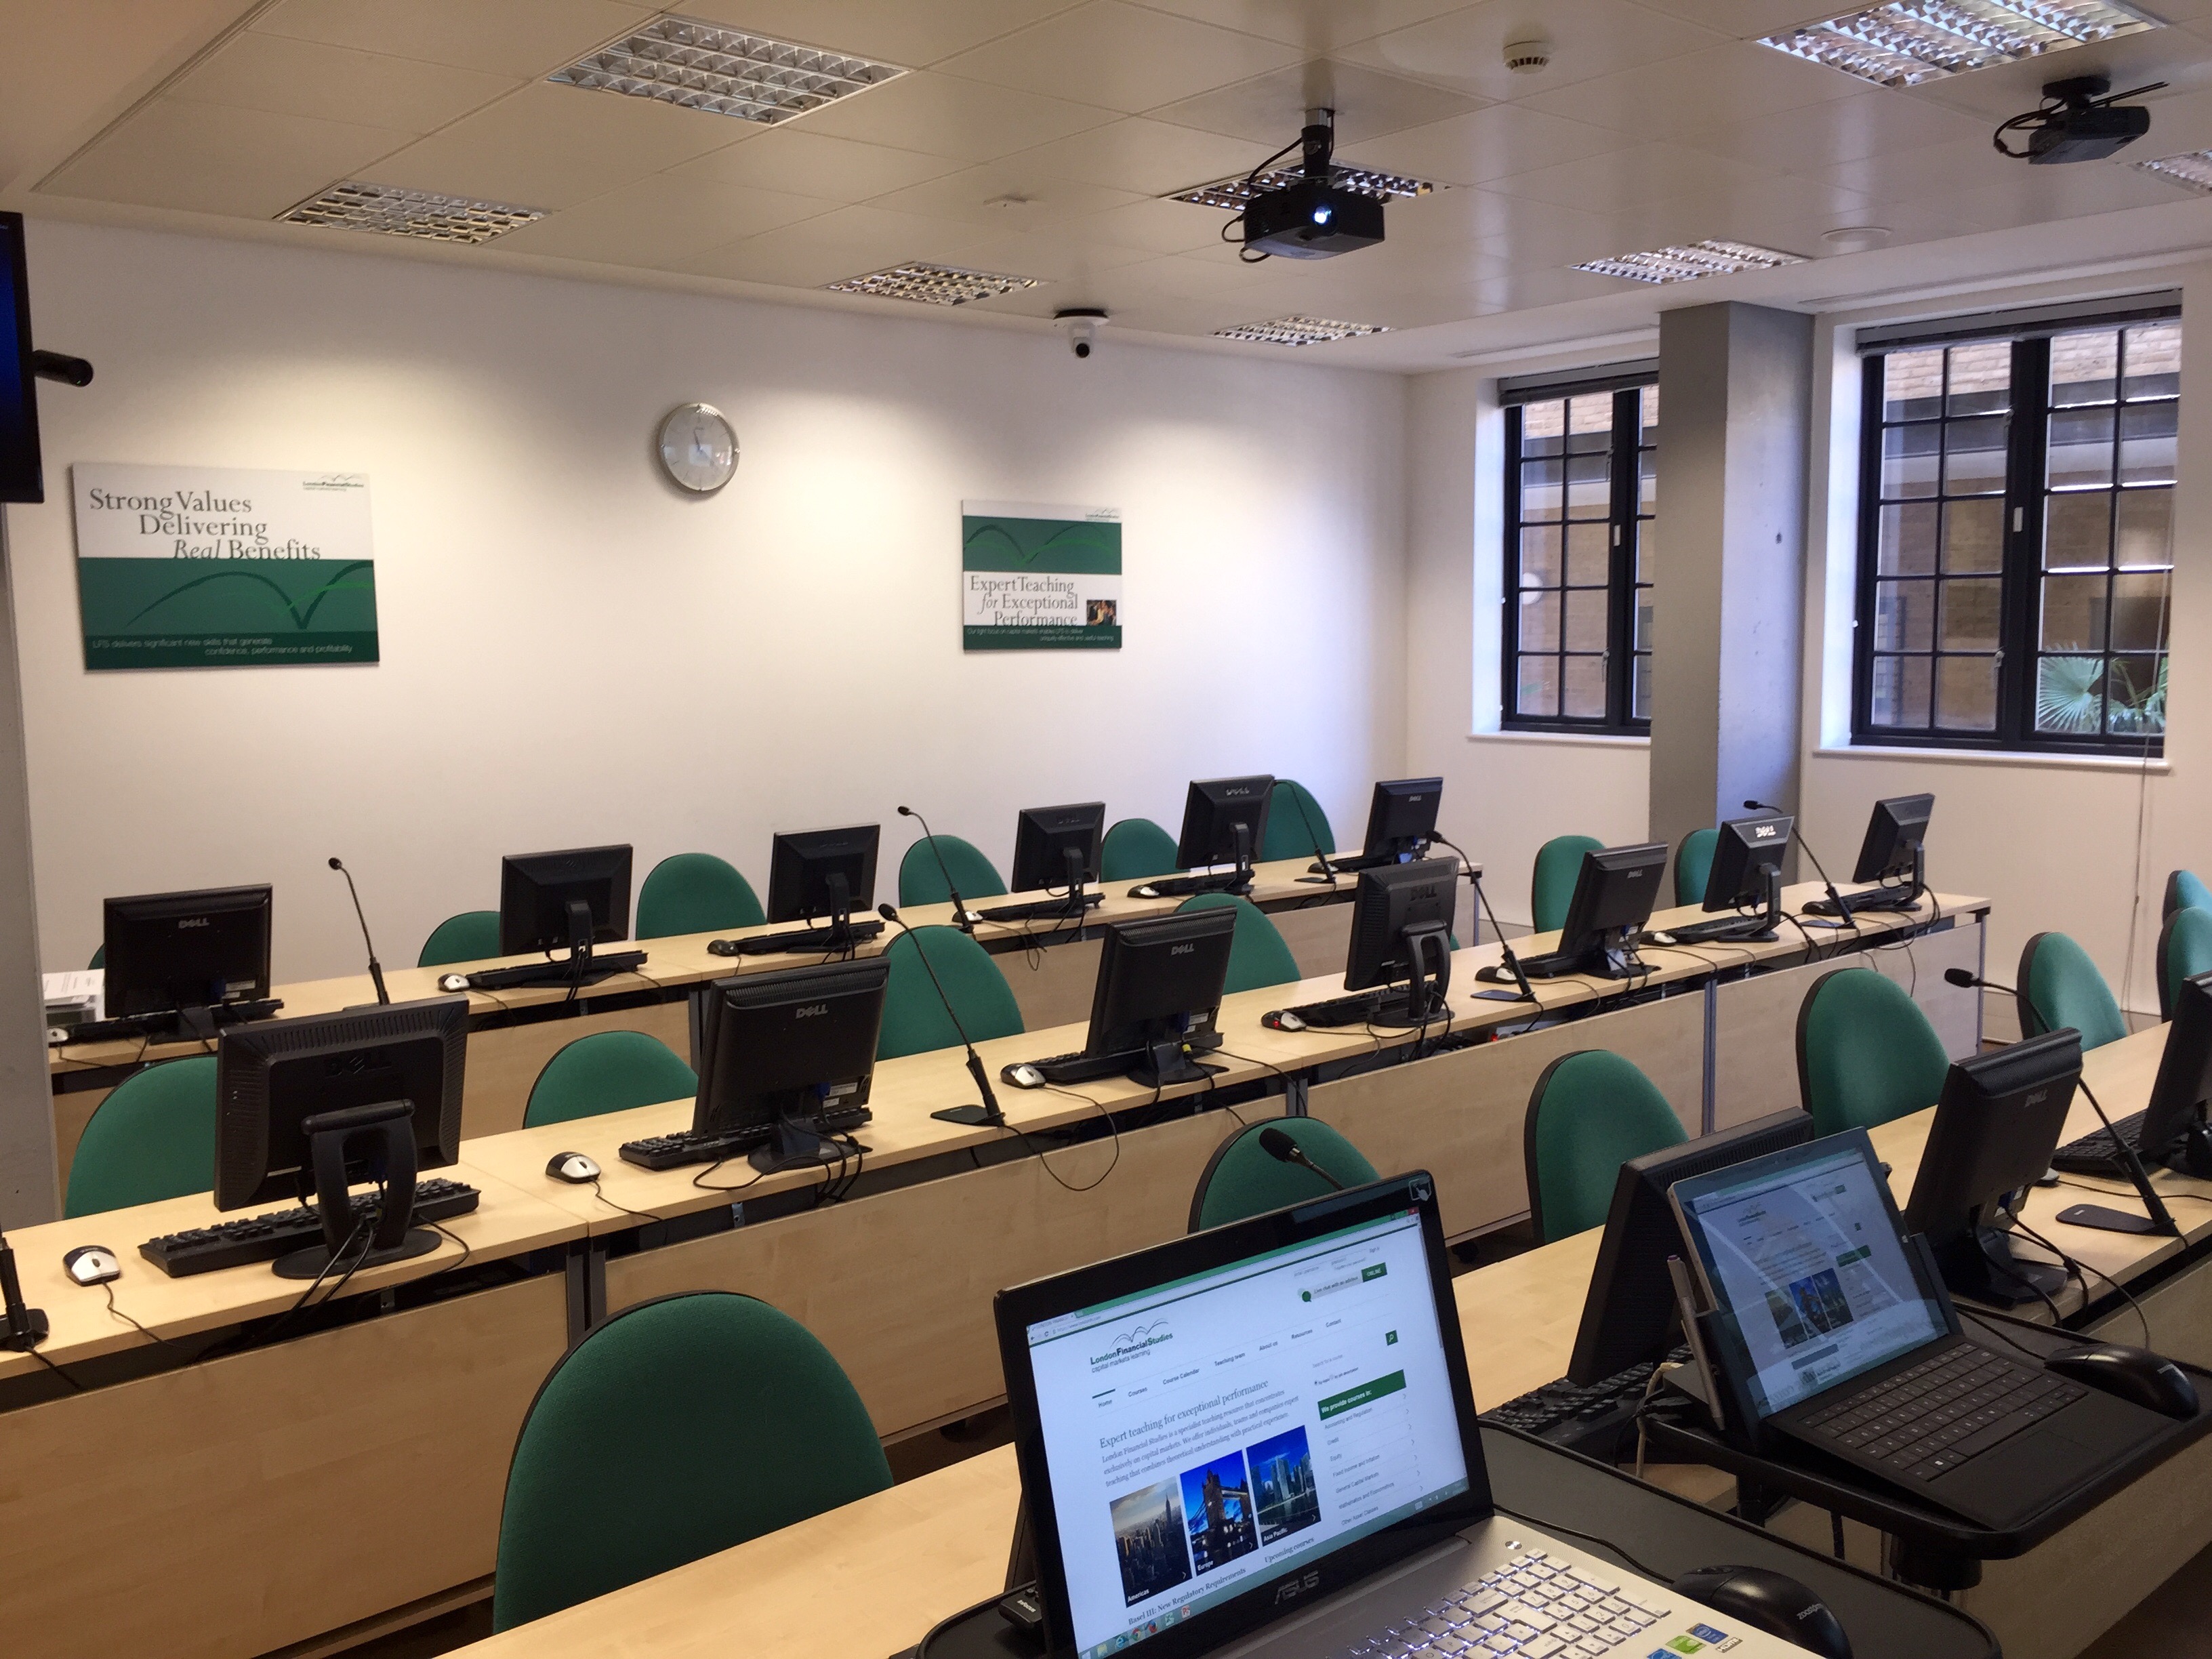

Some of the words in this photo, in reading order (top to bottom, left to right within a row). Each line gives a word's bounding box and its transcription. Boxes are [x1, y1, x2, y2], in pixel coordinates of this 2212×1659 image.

[89, 488, 173, 520] Strong
[175, 490, 252, 512] Values
[140, 513, 269, 546] Delivering
[173, 539, 222, 559] Real
[228, 538, 321, 560] Benefits
[970, 575, 1017, 597] Expert
[1017, 575, 1075, 599] Teaching
[977, 592, 999, 615] for
[1002, 593, 1079, 615] Exceptional
[994, 610, 1078, 626] Performance
[1755, 825, 1776, 838] DELL
[1627, 869, 1643, 878] DELL
[178, 917, 210, 929] DELL
[1170, 943, 1194, 956] DELL
[795, 1004, 829, 1019] DELL
[1325, 1318, 1342, 1328] Contact
[1291, 1329, 1313, 1339] Resources
[1089, 1332, 1174, 1366] LondonFinancialStudies
[1259, 1343, 1273, 1351] About
[1091, 1361, 1109, 1373] capital
[1109, 1355, 1130, 1368] markets
[1130, 1349, 1151, 1361] learning
[1214, 1355, 1235, 1366] Teaching
[1235, 1352, 1246, 1360] team
[1162, 1375, 1179, 1385] Course
[1179, 1368, 1200, 1379] Calendar
[1128, 1387, 1148, 1397] Courses
[1098, 1399, 1113, 1408] Home
[1321, 1405, 1330, 1414] We
[1330, 1399, 1347, 1412] provide
[1347, 1391, 1366, 1404] courses
[1099, 1431, 1128, 1449] Expert
[1128, 1418, 1164, 1437] teaching
[1164, 1413, 1176, 1425] for
[1177, 1395, 1221, 1419] exceptional
[1222, 1380, 1269, 1406] performance
[1353, 1407, 1373, 1419] Regulation
[1102, 1450, 1124, 1463] London
[1123, 1439, 1149, 1455] Financial
[1149, 1433, 1168, 1446] Studies
[1177, 1420, 1202, 1436] specialist
[1202, 1410, 1224, 1424] teaching
[1223, 1405, 1245, 1418] resource
[1244, 1399, 1254, 1409] that
[1254, 1390, 1285, 1405] concentrates
[1103, 1458, 1132, 1475] exclusively
[1141, 1448, 1159, 1462] capital
[1159, 1441, 1182, 1454] markets.
[1182, 1435, 1191, 1445] We
[1191, 1431, 1204, 1441] offer
[1233, 1415, 1248, 1425] teams
[1248, 1410, 1258, 1420] and
[1258, 1401, 1284, 1415] companies
[1284, 1395, 1299, 1406] expert
[1327, 1437, 1339, 1446] Credit
[1105, 1473, 1129, 1488] teaching
[1129, 1467, 1141, 1477] that
[1141, 1458, 1166, 1474] combines
[1166, 1446, 1194, 1463] theoretical
[1194, 1433, 1231, 1453] understanding
[1230, 1428, 1242, 1438] with
[1242, 1421, 1263, 1436] practical
[1330, 1453, 1342, 1462] Equity
[1332, 1469, 1344, 1477] Fixed
[1366, 1454, 1380, 1464] Inflation
[1336, 1483, 1351, 1494] General
[1351, 1478, 1364, 1488] Capital
[1263, 1532, 1273, 1542] Asia
[1273, 1526, 1288, 1538] Pacific
[1264, 1546, 1294, 1563] Upcoming
[1293, 1536, 1315, 1551] courses
[1197, 1559, 1214, 1572] Europe
[1127, 1588, 1150, 1603] Americas
[1274, 1570, 1320, 1605] ASUS
[1128, 1611, 1143, 1625] Basel
[1157, 1601, 1172, 1614] New
[1172, 1586, 1205, 1609] Regulatory
[1204, 1567, 1247, 1591] Requirements
[1796, 1603, 1824, 1620] zoosto
